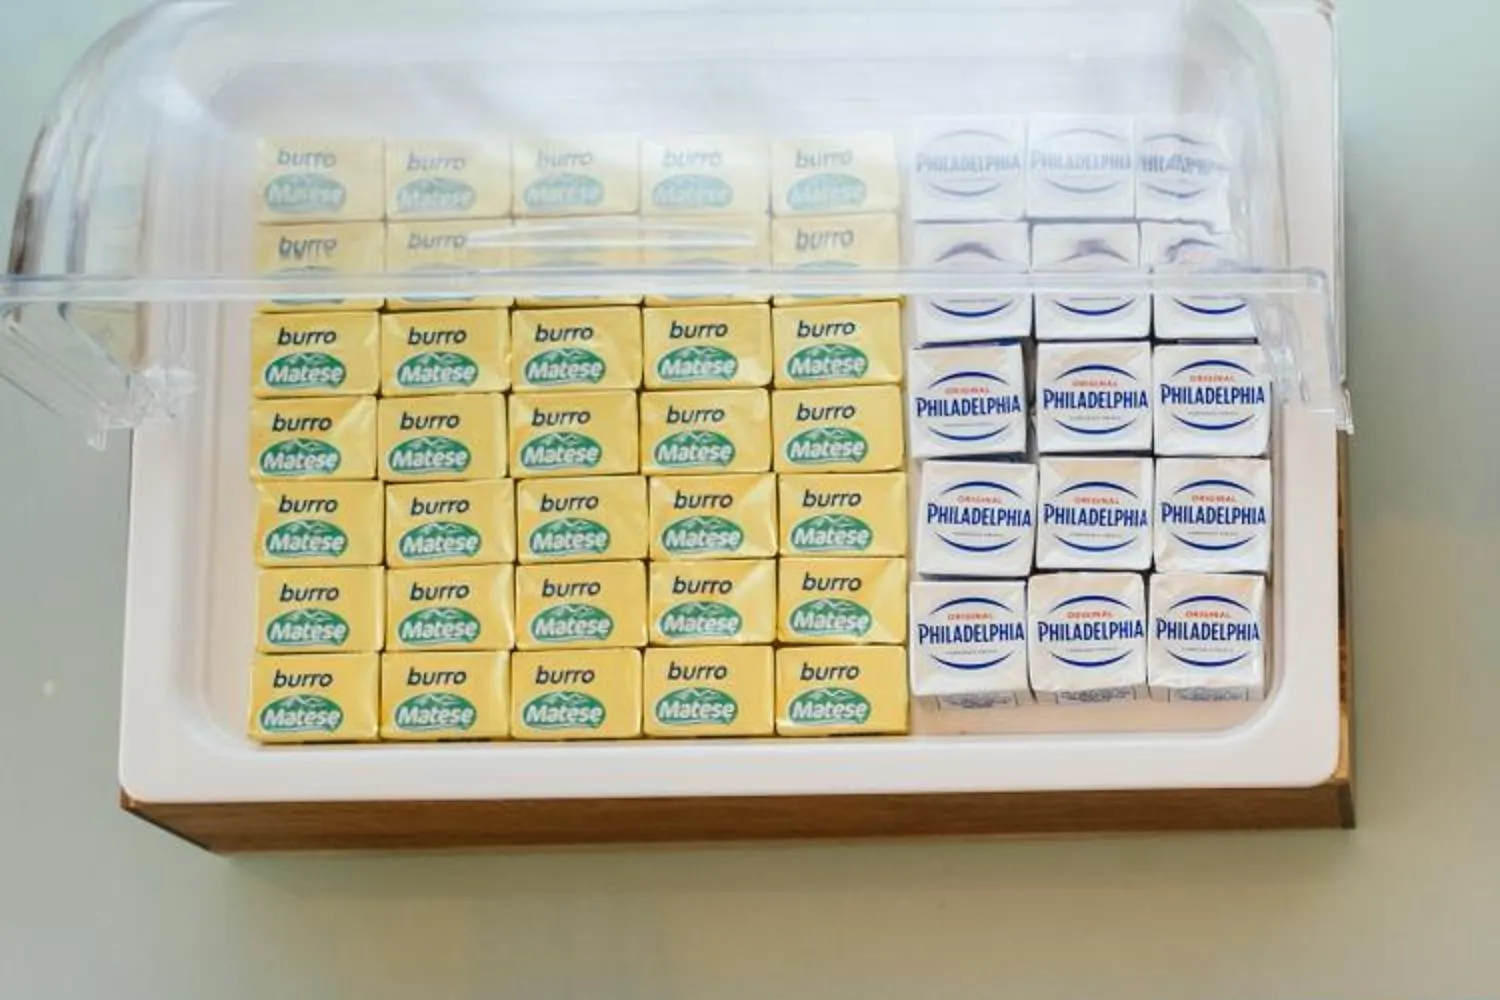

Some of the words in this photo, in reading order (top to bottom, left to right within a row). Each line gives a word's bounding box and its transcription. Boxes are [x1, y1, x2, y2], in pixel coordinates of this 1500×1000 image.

[278, 327, 336, 345] burro
[408, 327, 466, 345] burro
[535, 324, 593, 342] burro
[670, 321, 728, 338] burro
[797, 320, 855, 338] burro
[268, 362, 343, 384] Matese
[399, 362, 475, 382] Matese
[528, 358, 602, 378] Matese
[660, 357, 735, 375] Matese
[789, 354, 865, 373] Matese
[1043, 389, 1148, 409] PHILADELPHIA
[1161, 383, 1264, 404] PHILADELPHIA
[666, 406, 724, 424] burro
[797, 404, 855, 421] burro
[917, 395, 1020, 418] PHILADELPHIA
[272, 414, 332, 432] burro
[400, 412, 460, 430] burro
[532, 408, 590, 426] burro
[524, 445, 599, 464] Matese
[658, 444, 732, 463] Matese
[789, 439, 865, 457] Matese
[263, 451, 338, 469] Matese
[391, 449, 468, 468] Matese
[279, 495, 338, 513] burro
[411, 498, 469, 515] burro
[540, 494, 598, 512] burro
[674, 490, 733, 509] burro
[803, 489, 861, 507] burro
[927, 503, 1031, 527] PHILADELPHIA
[1044, 503, 1148, 527] PHILADELPHIA
[1161, 503, 1265, 525] PHILADELPHIA
[269, 533, 345, 552] Matese
[401, 534, 479, 553] Matese
[532, 529, 606, 549] Matese
[664, 528, 741, 547] Matese
[793, 527, 869, 545] Matese
[542, 579, 600, 597] burro
[673, 576, 732, 594] burro
[802, 572, 862, 591] burro
[280, 584, 339, 602] burro
[410, 583, 469, 600] burro
[401, 620, 478, 639] Matese
[534, 615, 611, 634] Matese
[663, 613, 739, 632] Matese
[792, 611, 868, 629] Matese
[1156, 618, 1260, 641] PHILADELPHIA
[270, 621, 346, 641] Matese
[919, 623, 1024, 644] PHILADELPHIA
[1038, 619, 1144, 642] PHILADELPHIA
[274, 670, 333, 688] burro
[407, 668, 466, 685] burro
[536, 666, 595, 684] burro
[668, 662, 727, 680] burro
[800, 662, 859, 680] burro
[263, 707, 339, 726] Matese
[398, 705, 473, 724] Matese
[526, 705, 603, 723] Matese
[658, 700, 734, 719] Matese
[791, 700, 868, 719] Matese
